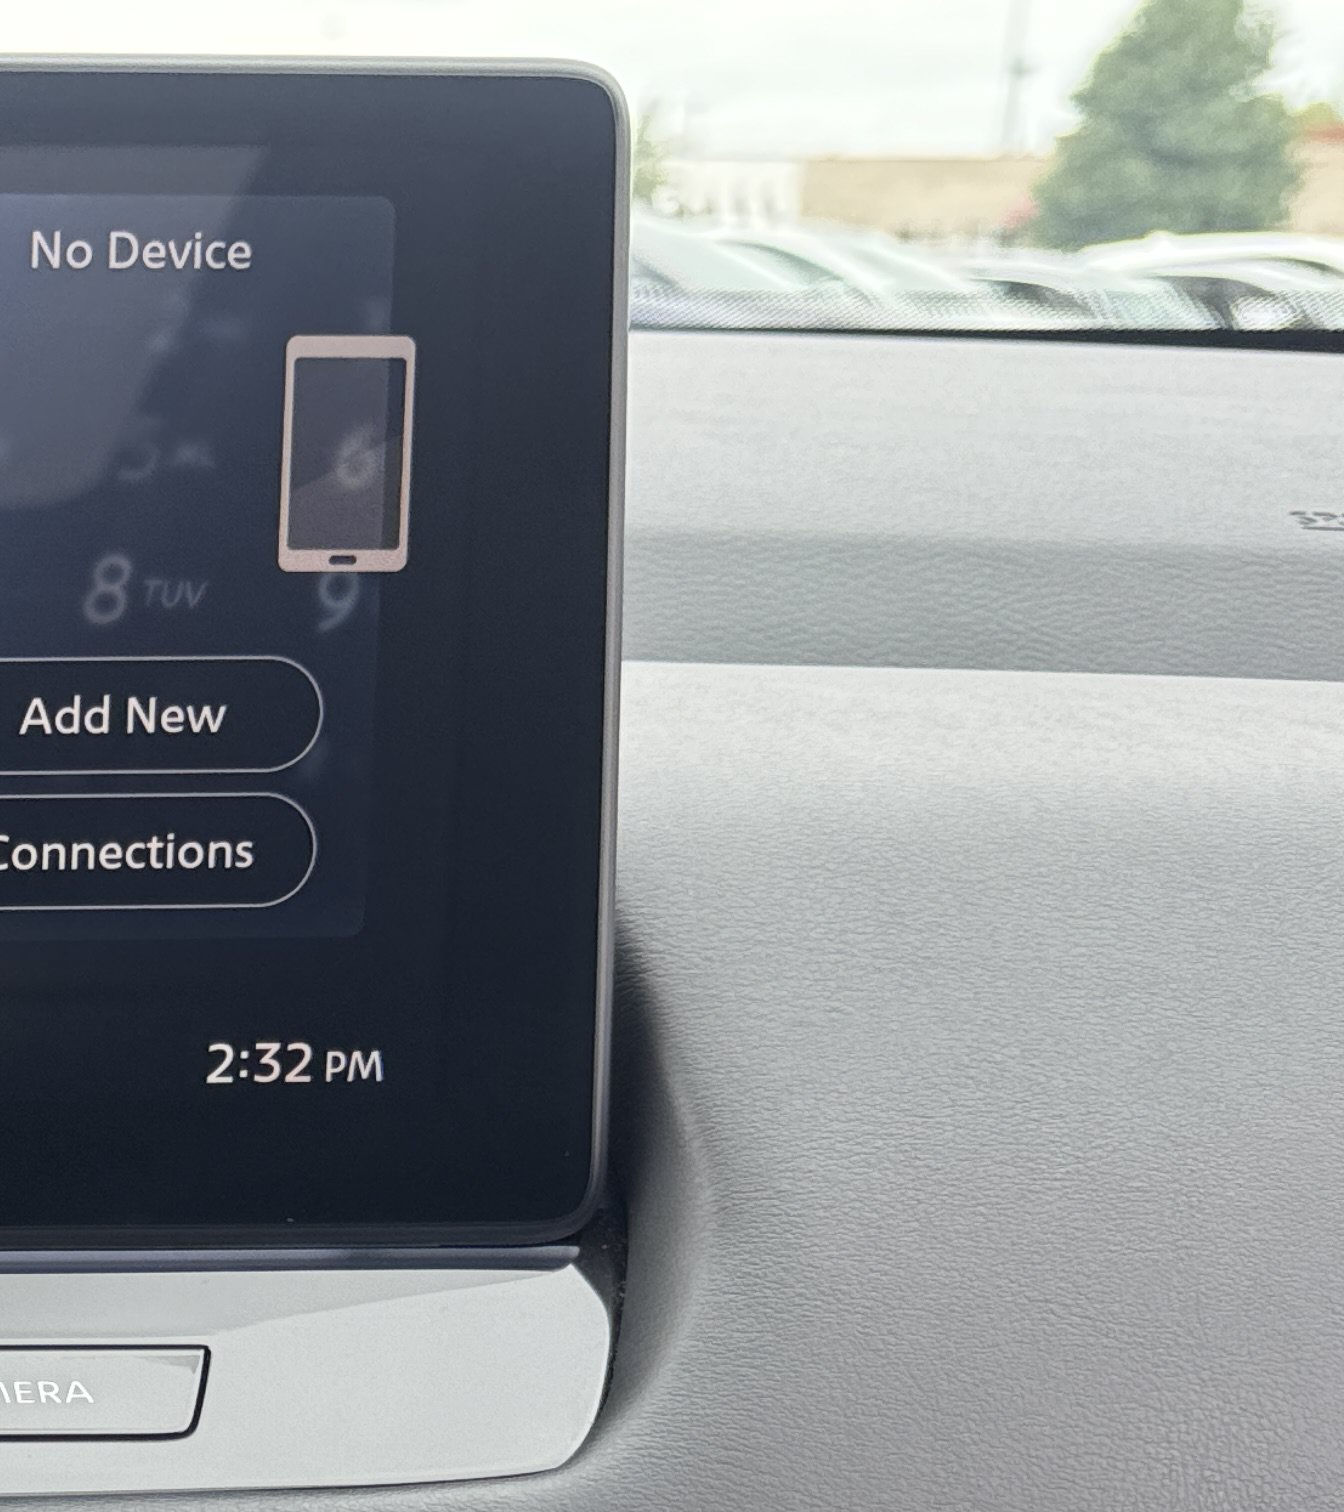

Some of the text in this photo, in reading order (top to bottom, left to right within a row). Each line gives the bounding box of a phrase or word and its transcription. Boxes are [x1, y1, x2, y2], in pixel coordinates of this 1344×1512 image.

[31, 230, 252, 269] No Device
[83, 550, 209, 625] 8 TUV
[19, 694, 227, 735] Add New
[206, 1042, 383, 1084] 2:32 PM
